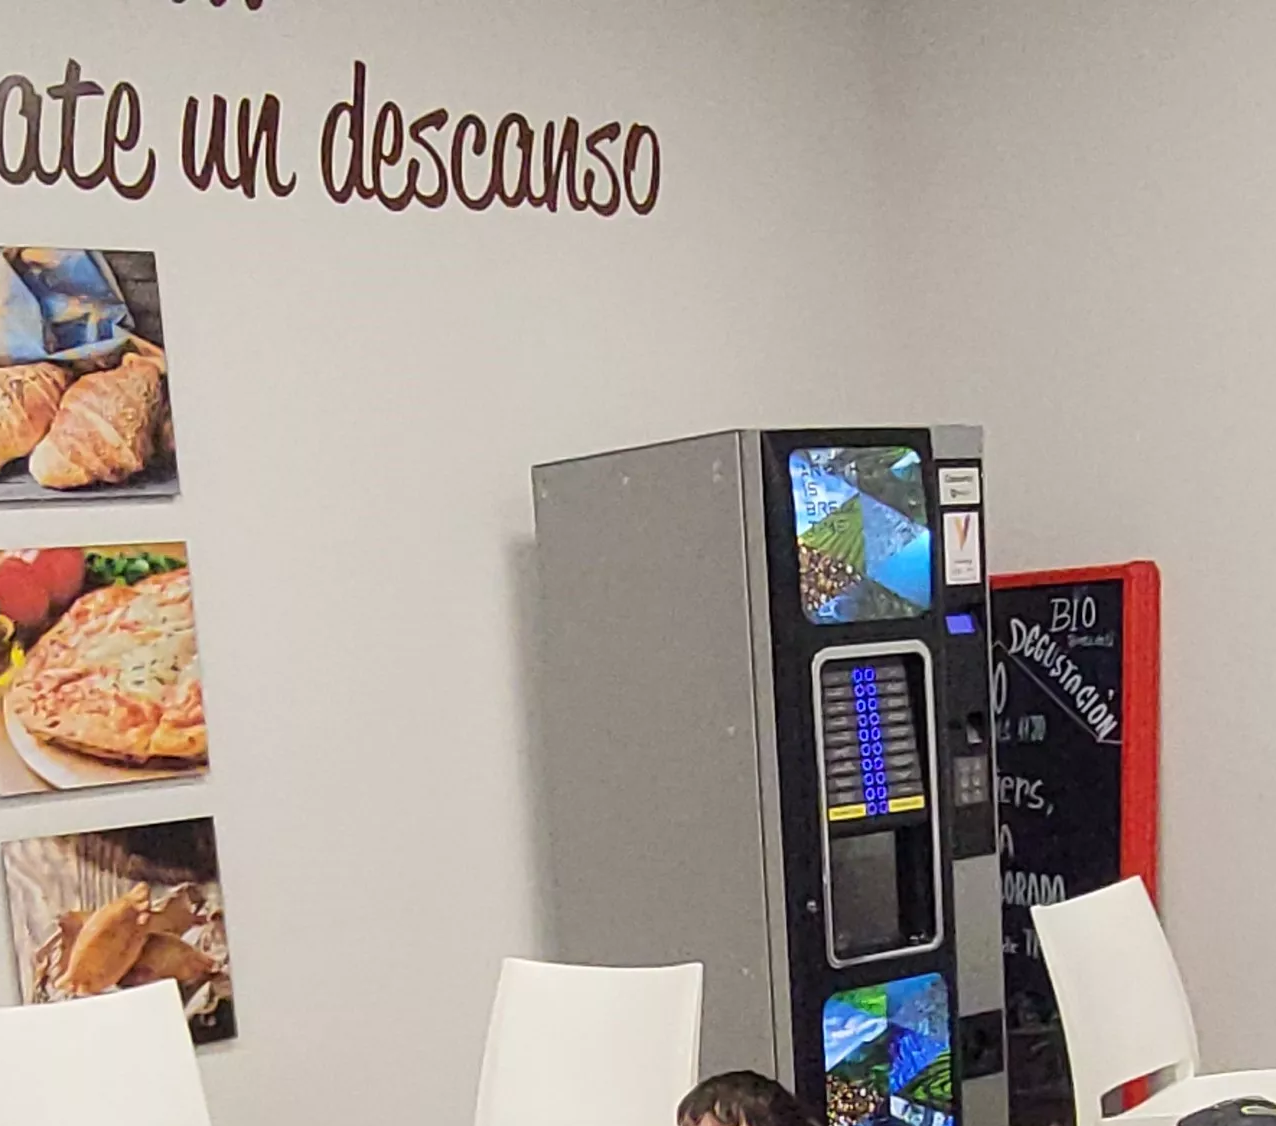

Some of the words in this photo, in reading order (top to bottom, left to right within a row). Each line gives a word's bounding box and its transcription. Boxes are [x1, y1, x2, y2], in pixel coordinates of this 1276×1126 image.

[181, 92, 297, 198] un
[321, 60, 662, 216] descanso
[1049, 596, 1097, 633] BIO
[1007, 617, 1119, 744] DEGUSTACIÓN
